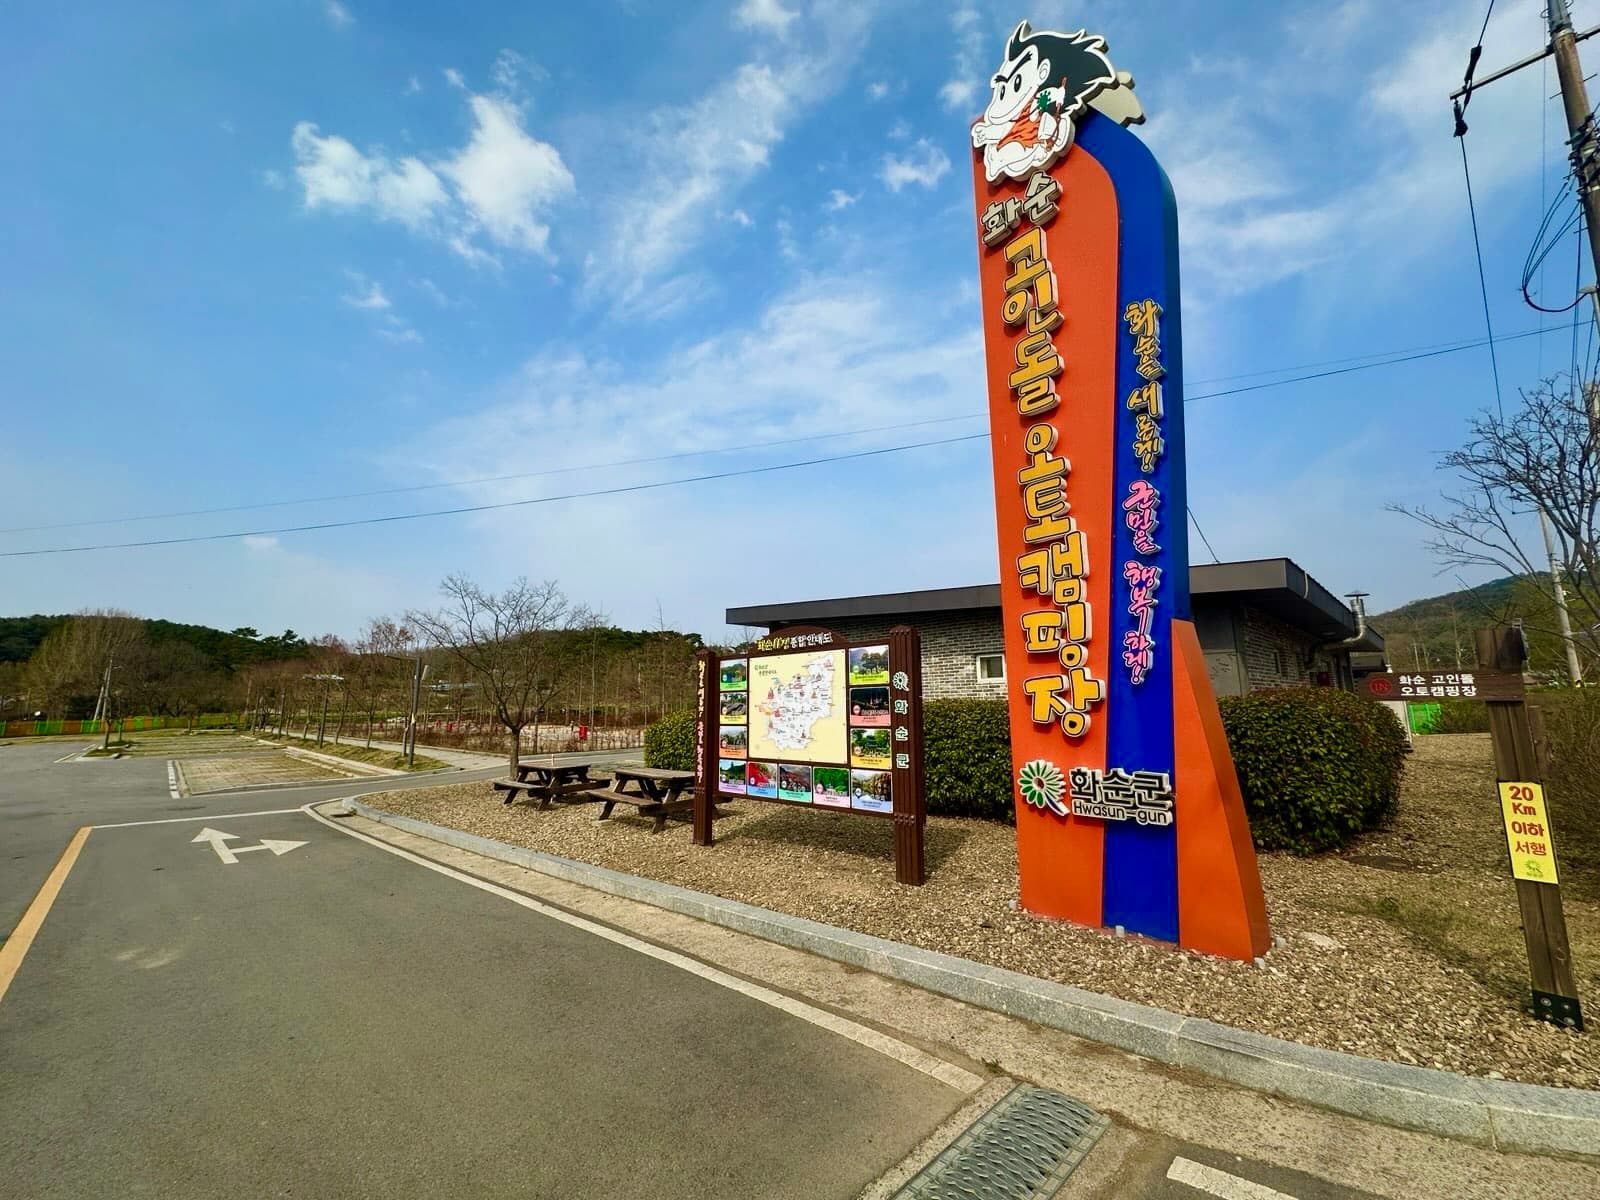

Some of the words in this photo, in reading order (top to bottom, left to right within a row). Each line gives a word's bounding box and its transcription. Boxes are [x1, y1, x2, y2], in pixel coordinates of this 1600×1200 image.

[981, 171, 1062, 246] 화순
[1002, 227, 1064, 416] 고인돌
[1017, 423, 1106, 738] 오토캠핑장
[1399, 675, 1426, 685] 화순
[1432, 674, 1474, 685] 고인돌
[1401, 685, 1477, 697] 오토캠핑장
[1070, 767, 1173, 805] 화순군
[1509, 786, 1534, 801] 20
[1073, 801, 1170, 825] Hwasun-gun
[1512, 802, 1537, 816] Km
[1511, 821, 1545, 837] 이하
[1515, 842, 1547, 857] 서행
